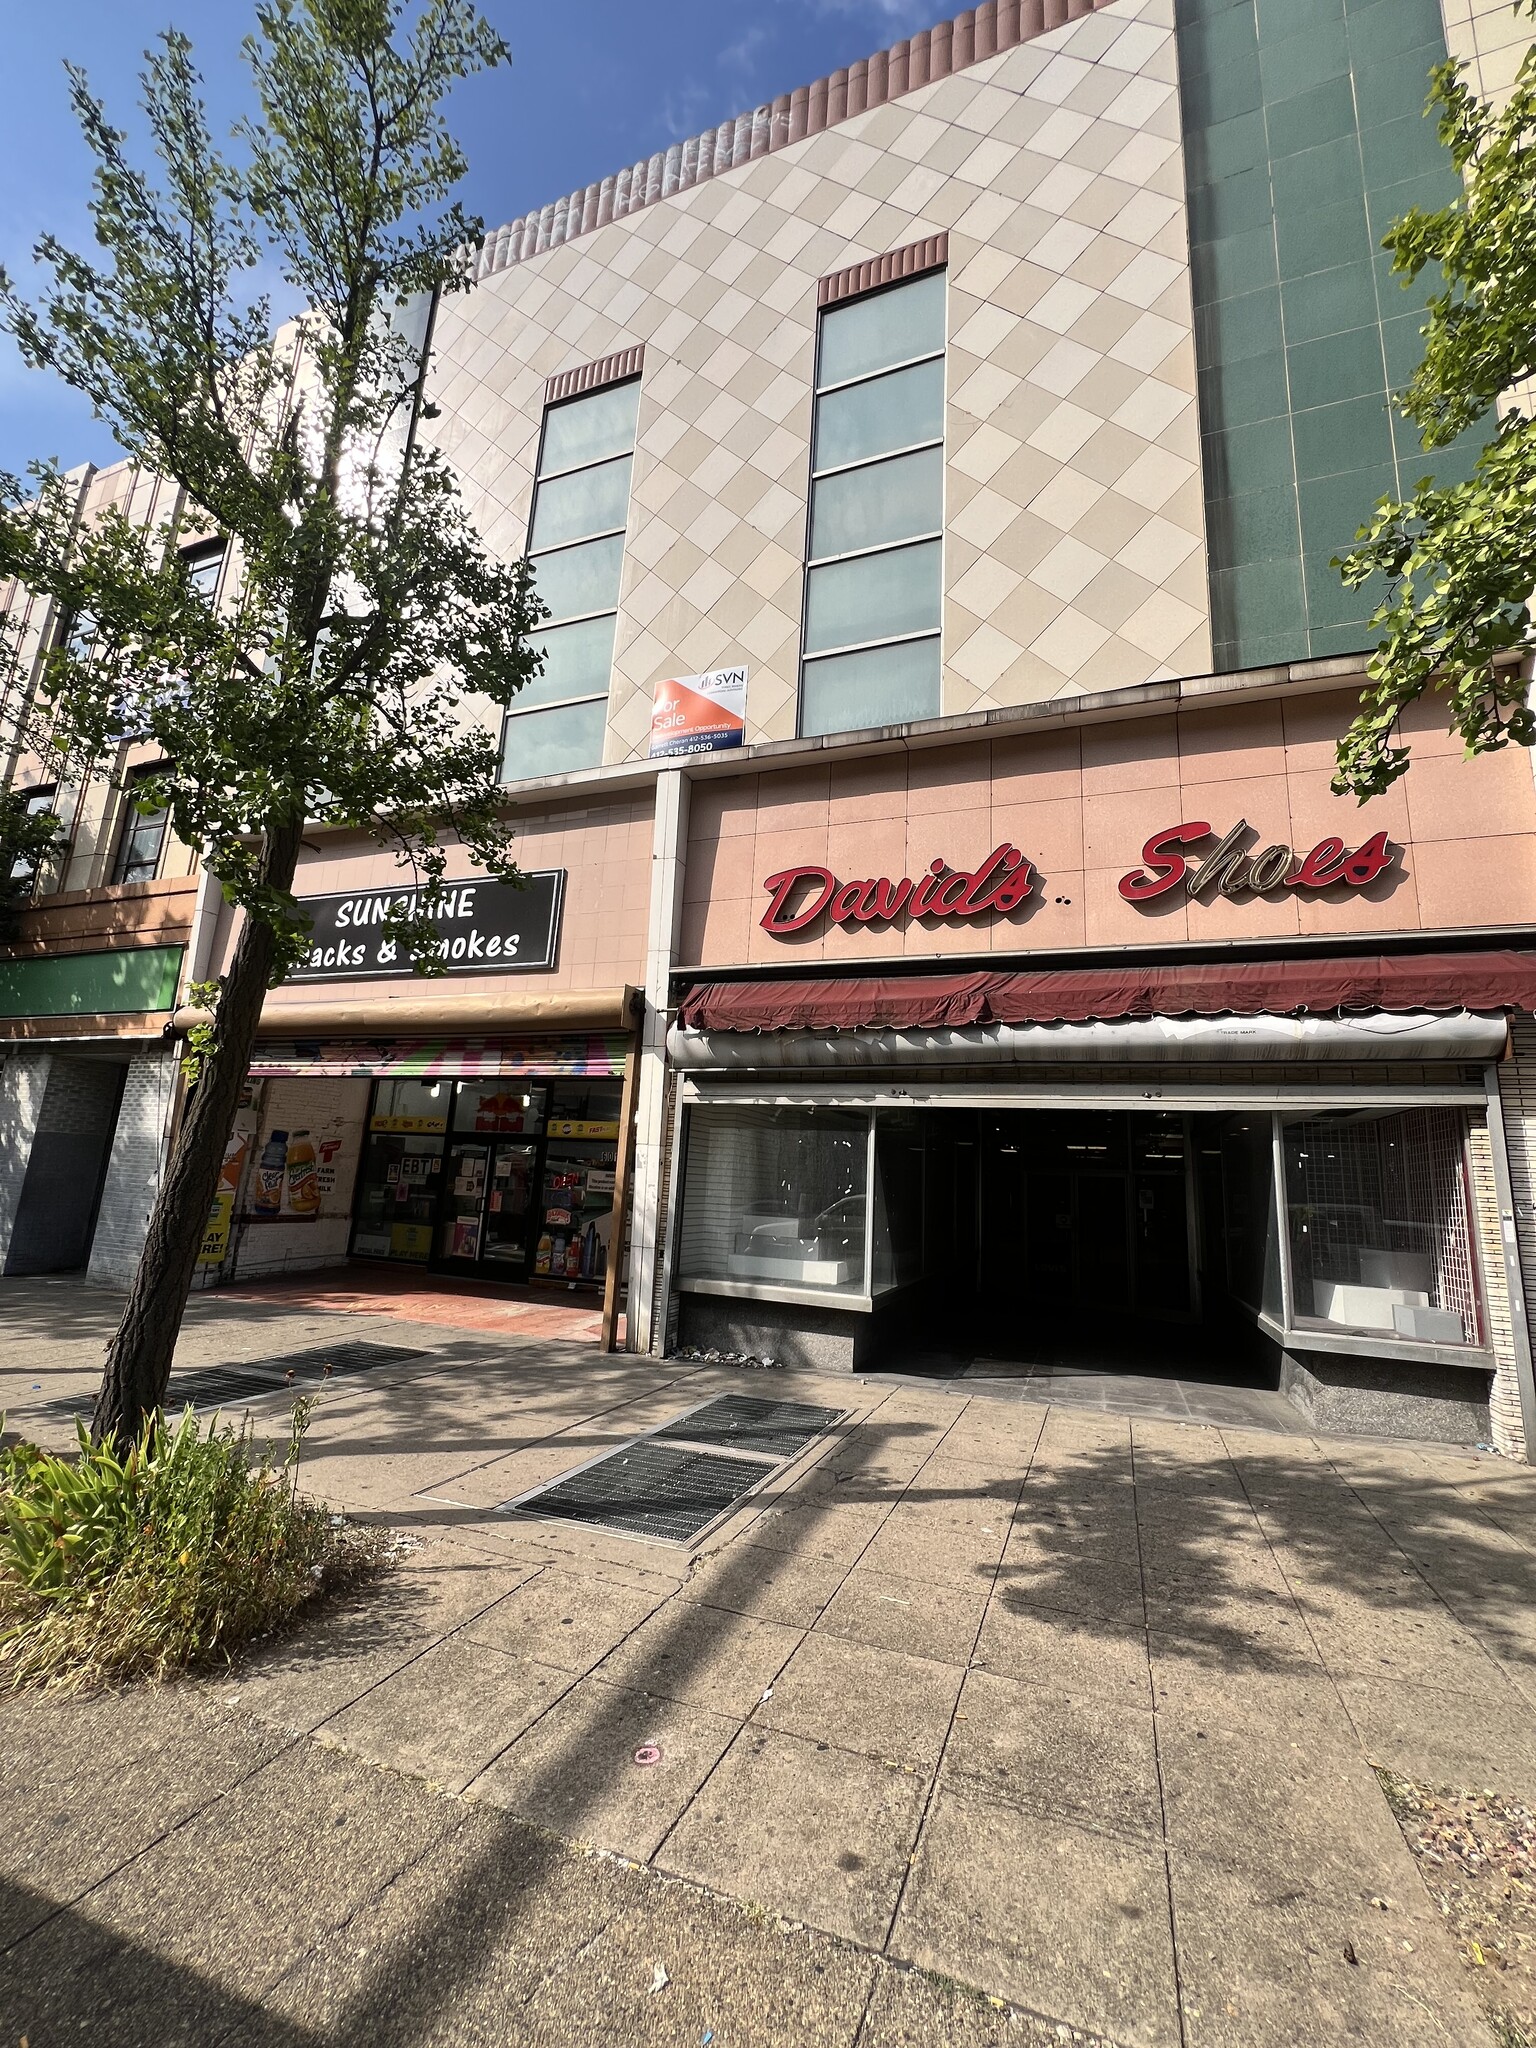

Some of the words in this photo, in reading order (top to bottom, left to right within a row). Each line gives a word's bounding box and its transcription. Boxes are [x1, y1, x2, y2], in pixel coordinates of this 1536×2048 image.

[715, 671, 744, 686] SVN
[662, 700, 680, 713] or
[654, 713, 686, 731] Sale
[694, 723, 731, 732] Opportunity
[759, 843, 1036, 933] David's
[1118, 818, 1397, 902] Shoes
[376, 939, 397, 964] &
[402, 1159, 430, 1175] EBT
[552, 1172, 579, 1188] OPEN
